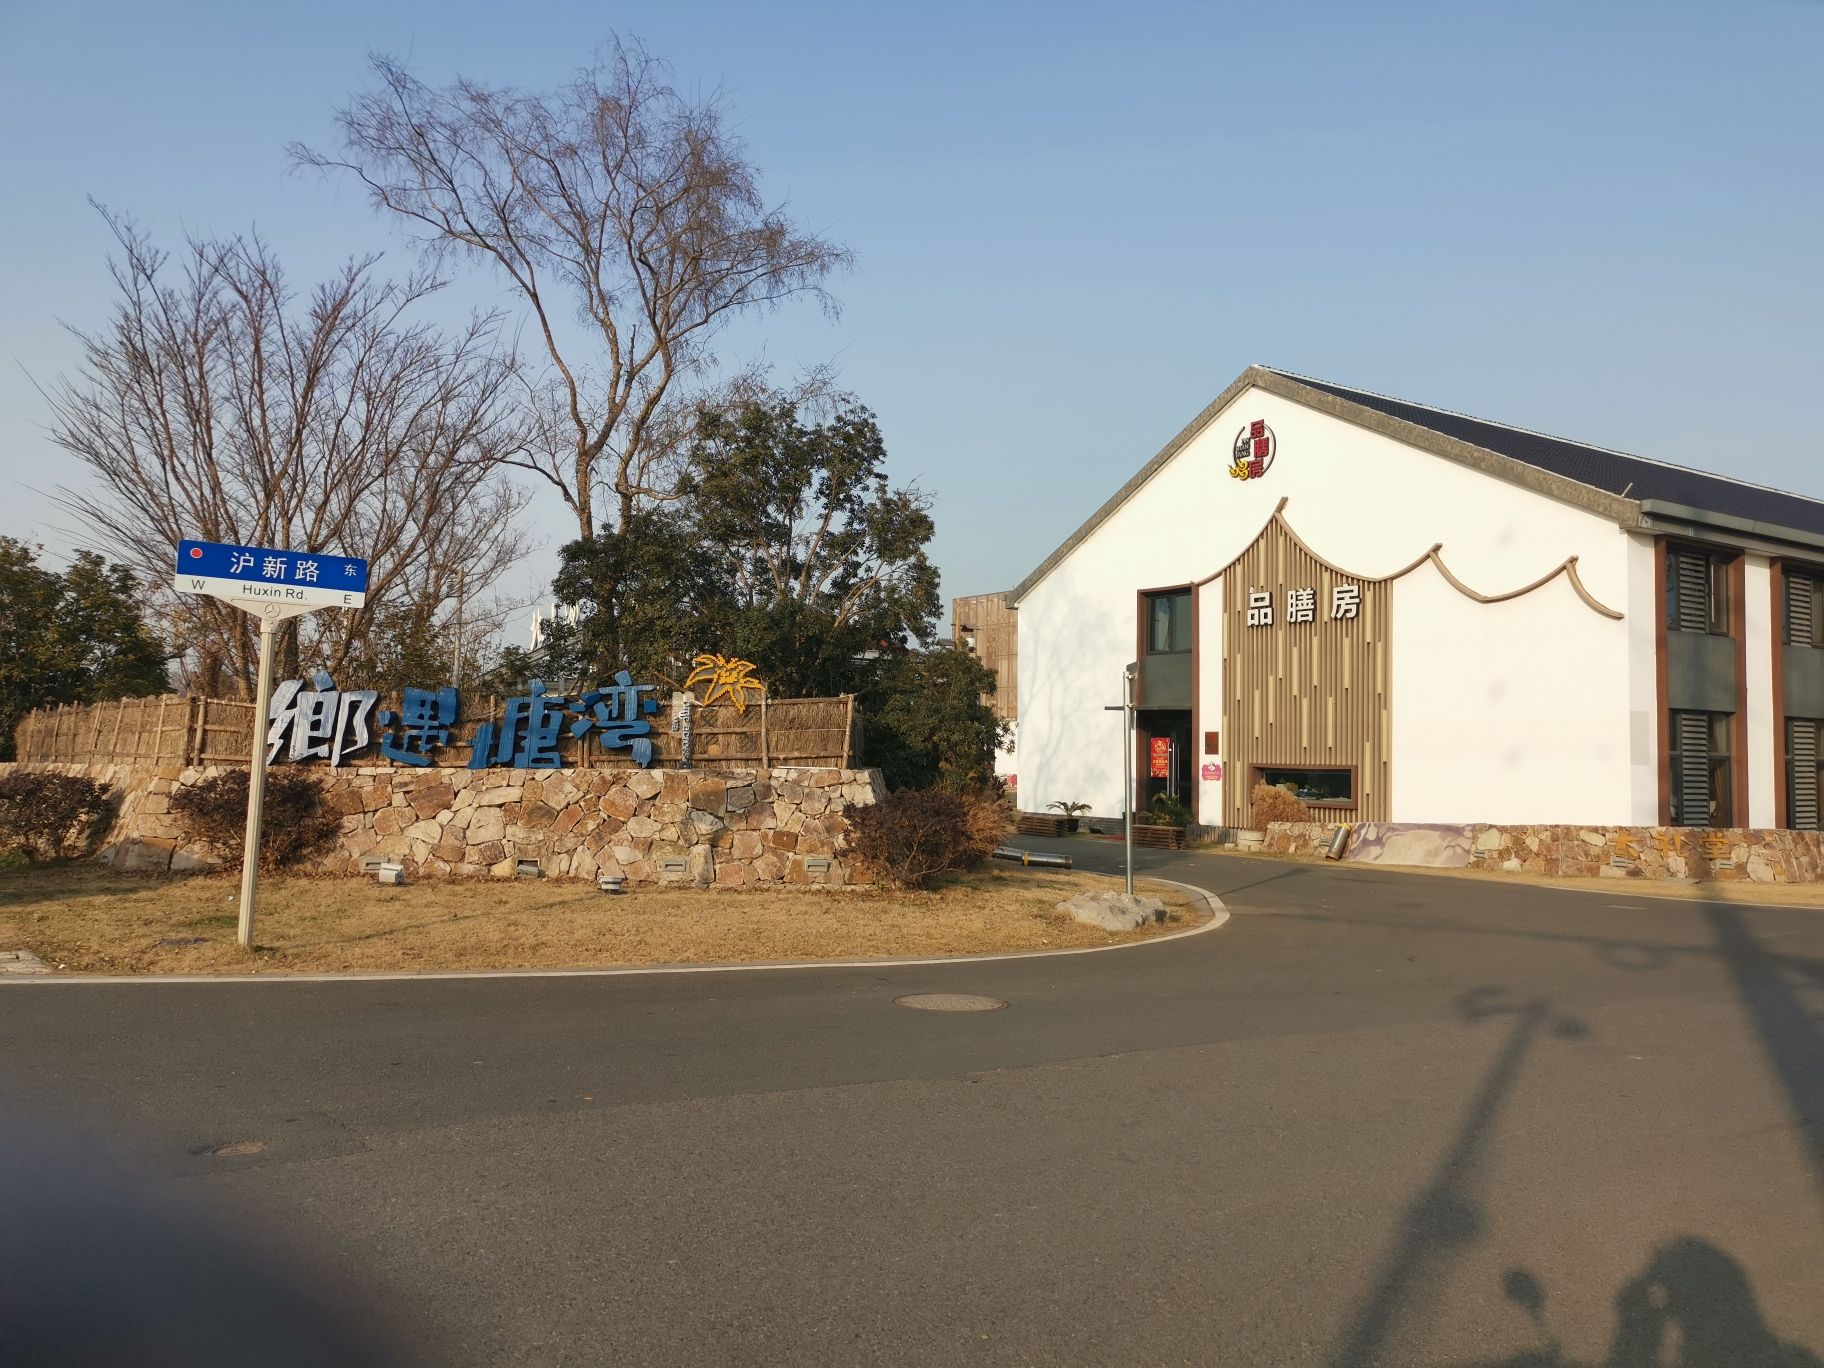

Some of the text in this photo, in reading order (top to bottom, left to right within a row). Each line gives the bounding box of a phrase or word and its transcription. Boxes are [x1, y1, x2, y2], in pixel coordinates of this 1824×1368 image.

[229, 551, 320, 583] 沪新路
[344, 563, 358, 577] 东
[191, 579, 206, 591] W
[242, 584, 308, 600] Huxin Rd.
[343, 594, 353, 605] E
[1247, 583, 1361, 627] 品膳房
